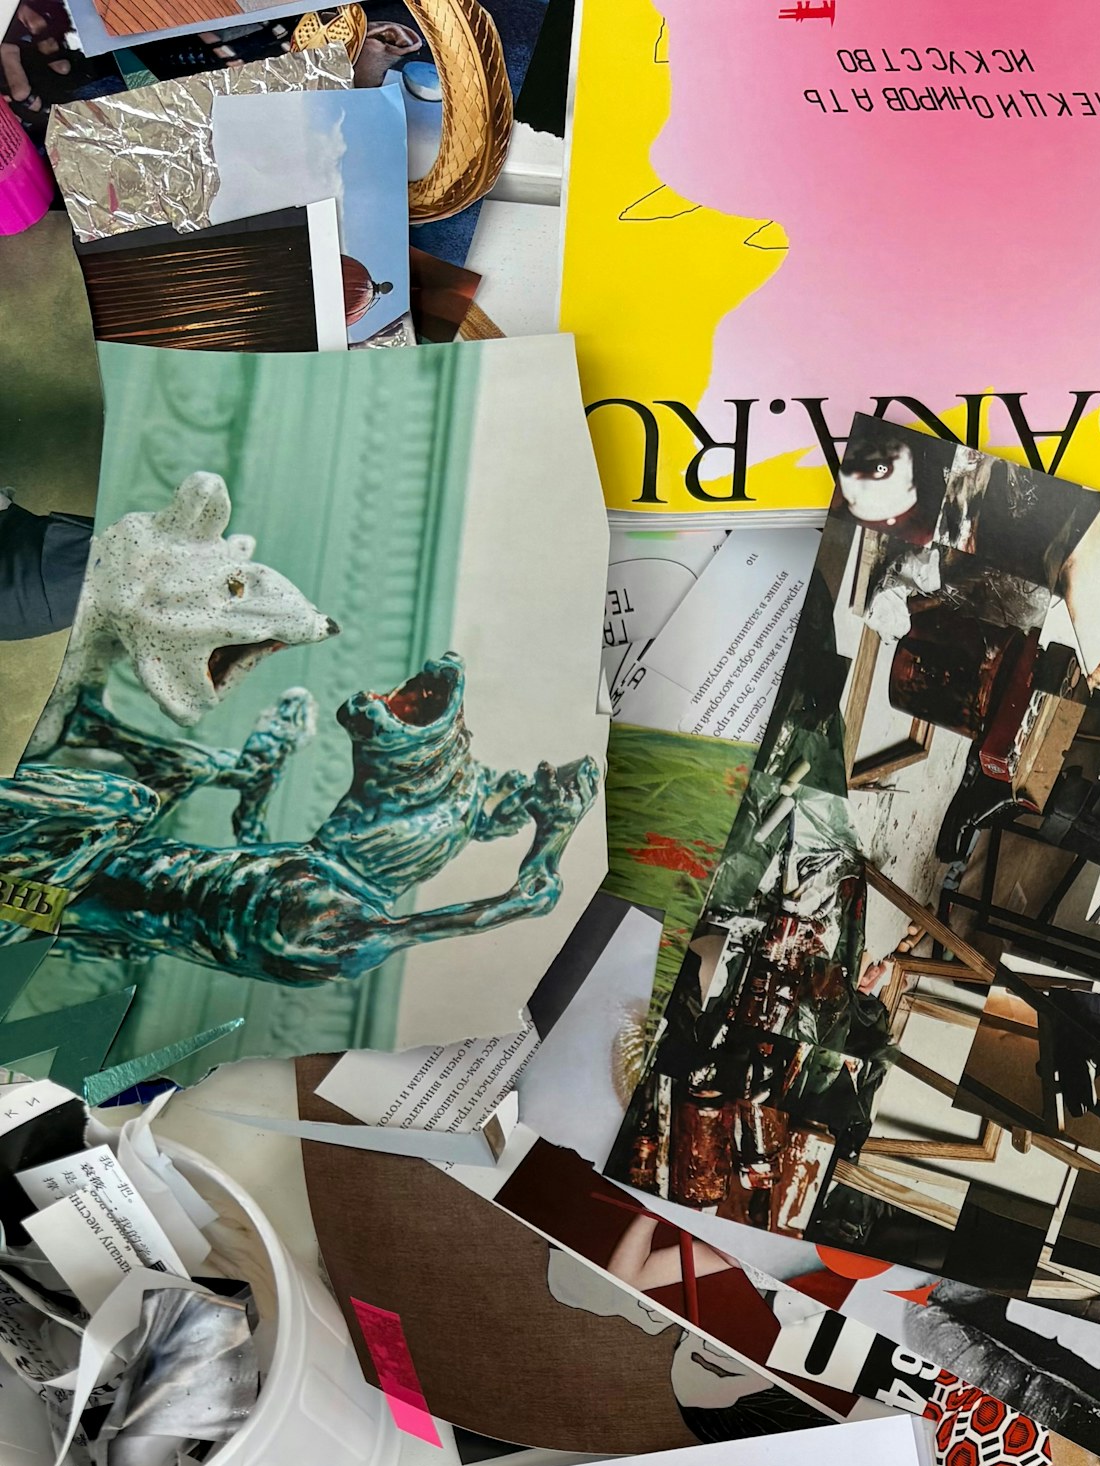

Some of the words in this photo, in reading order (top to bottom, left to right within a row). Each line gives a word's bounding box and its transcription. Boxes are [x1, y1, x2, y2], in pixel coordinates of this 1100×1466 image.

[837, 47, 1035, 76] ИСКУССТВО
[726, 608, 760, 656] заданной
[753, 580, 805, 649] гармоничный
